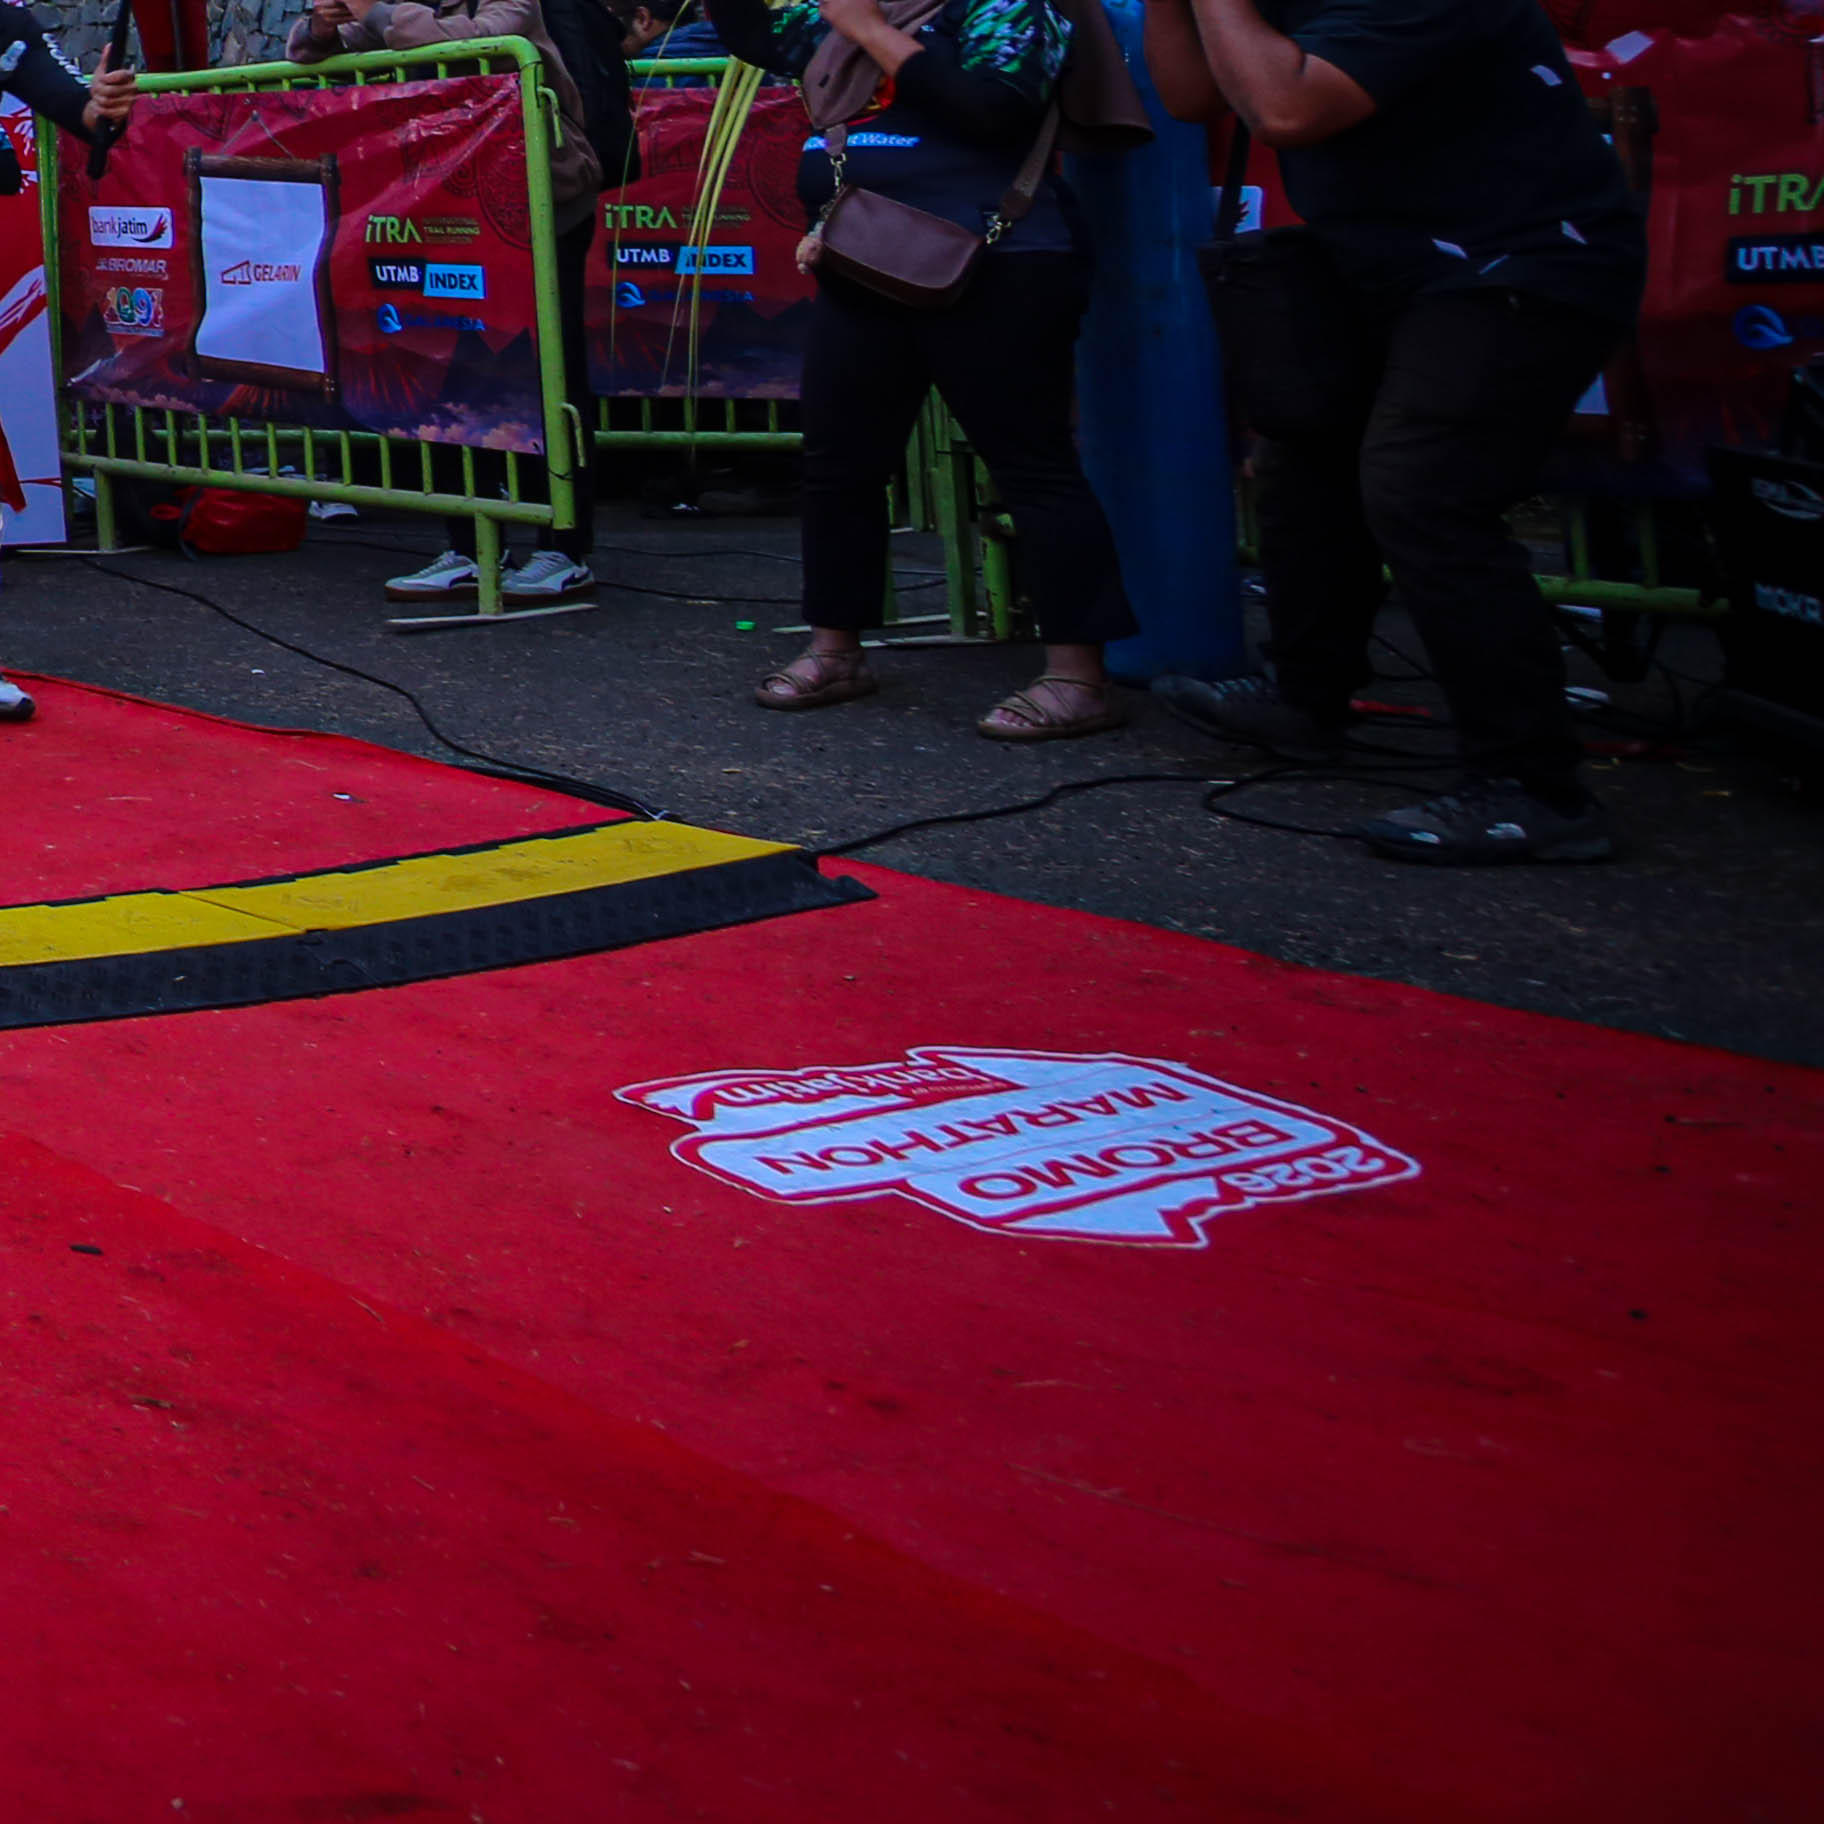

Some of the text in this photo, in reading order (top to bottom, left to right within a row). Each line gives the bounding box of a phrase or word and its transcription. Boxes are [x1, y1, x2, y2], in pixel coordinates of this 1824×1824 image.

[90, 214, 148, 238] bankjatim
[615, 247, 671, 265] UTMB
[684, 251, 747, 270] INDEX
[253, 262, 301, 283] GELARIN
[375, 264, 420, 283] UTMB
[429, 273, 479, 292] INDEX
[715, 1064, 980, 1108] bankjatim
[758, 1081, 1191, 1175] MARATHON
[957, 1119, 1296, 1201] BROMO
[1224, 1144, 1386, 1192] 2026
